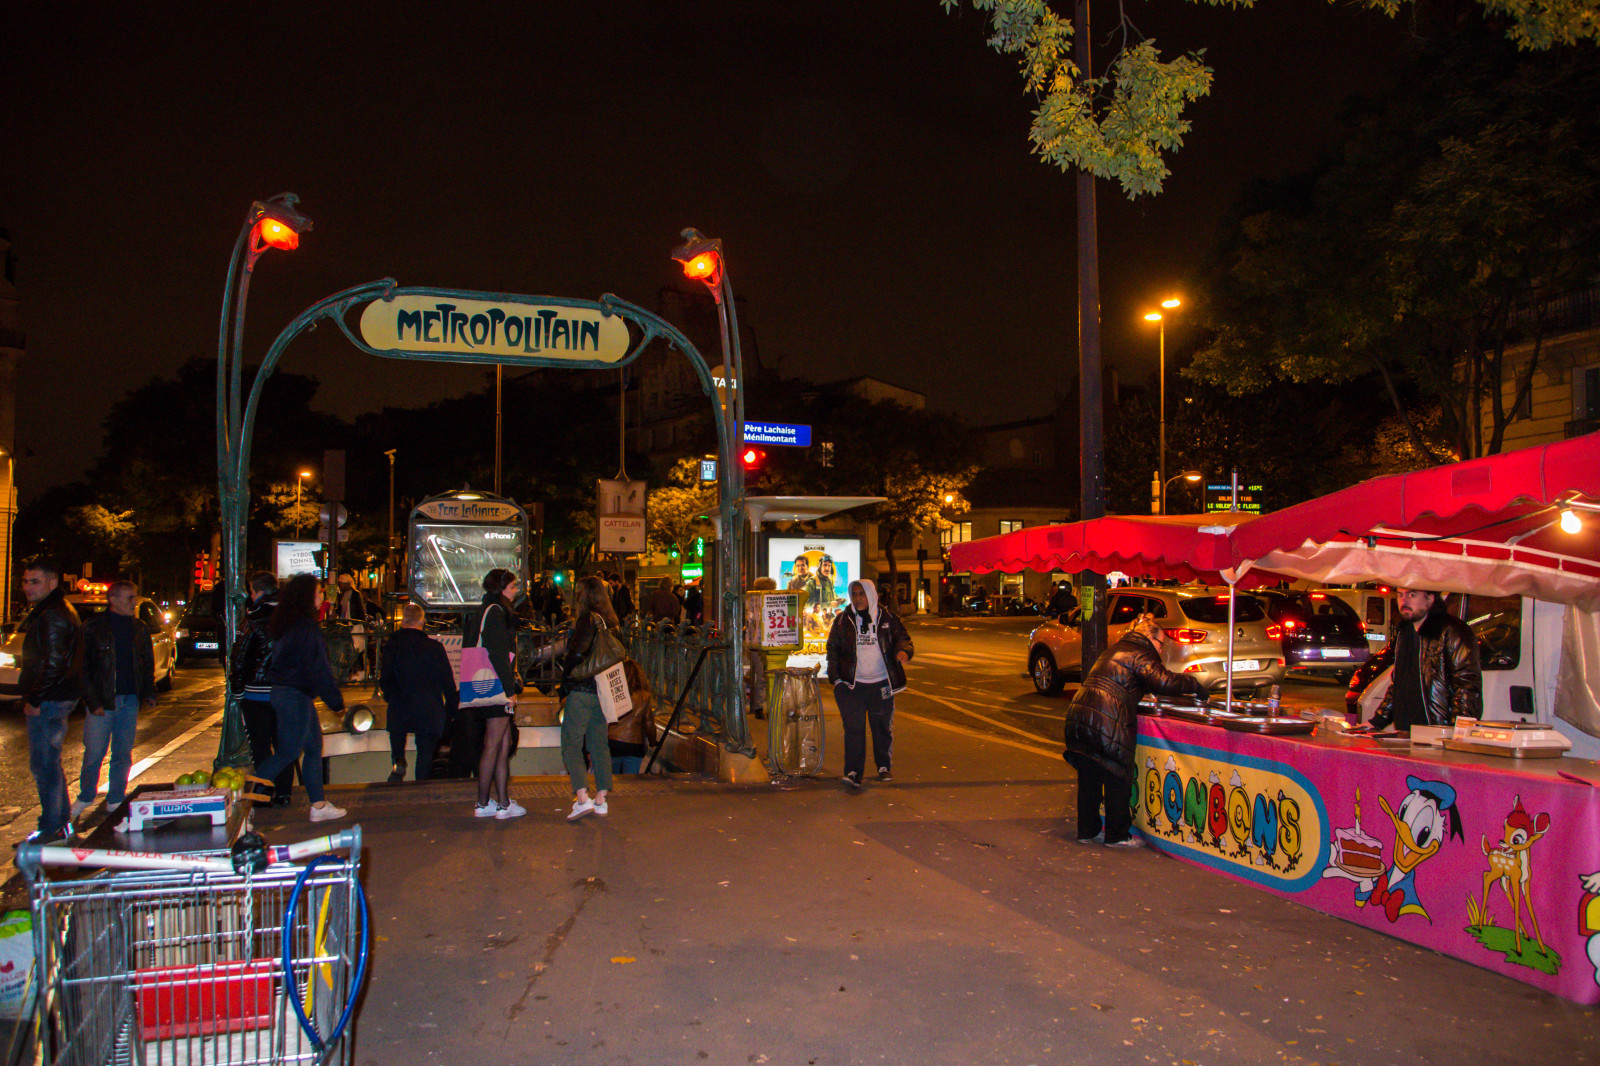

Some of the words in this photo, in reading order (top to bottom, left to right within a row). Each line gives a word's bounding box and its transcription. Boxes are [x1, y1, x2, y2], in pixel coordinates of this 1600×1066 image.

[397, 303, 600, 353] METROPOLITAIN
[744, 424, 763, 433] Père
[763, 425, 796, 435] Lachaise
[743, 433, 797, 443] Ménilmontant
[604, 520, 641, 528] CATTELAN
[490, 532, 511, 540] iPhone
[767, 610, 777, 618] 35
[768, 616, 785, 629] 32
[1144, 767, 1302, 862] BONBONS
